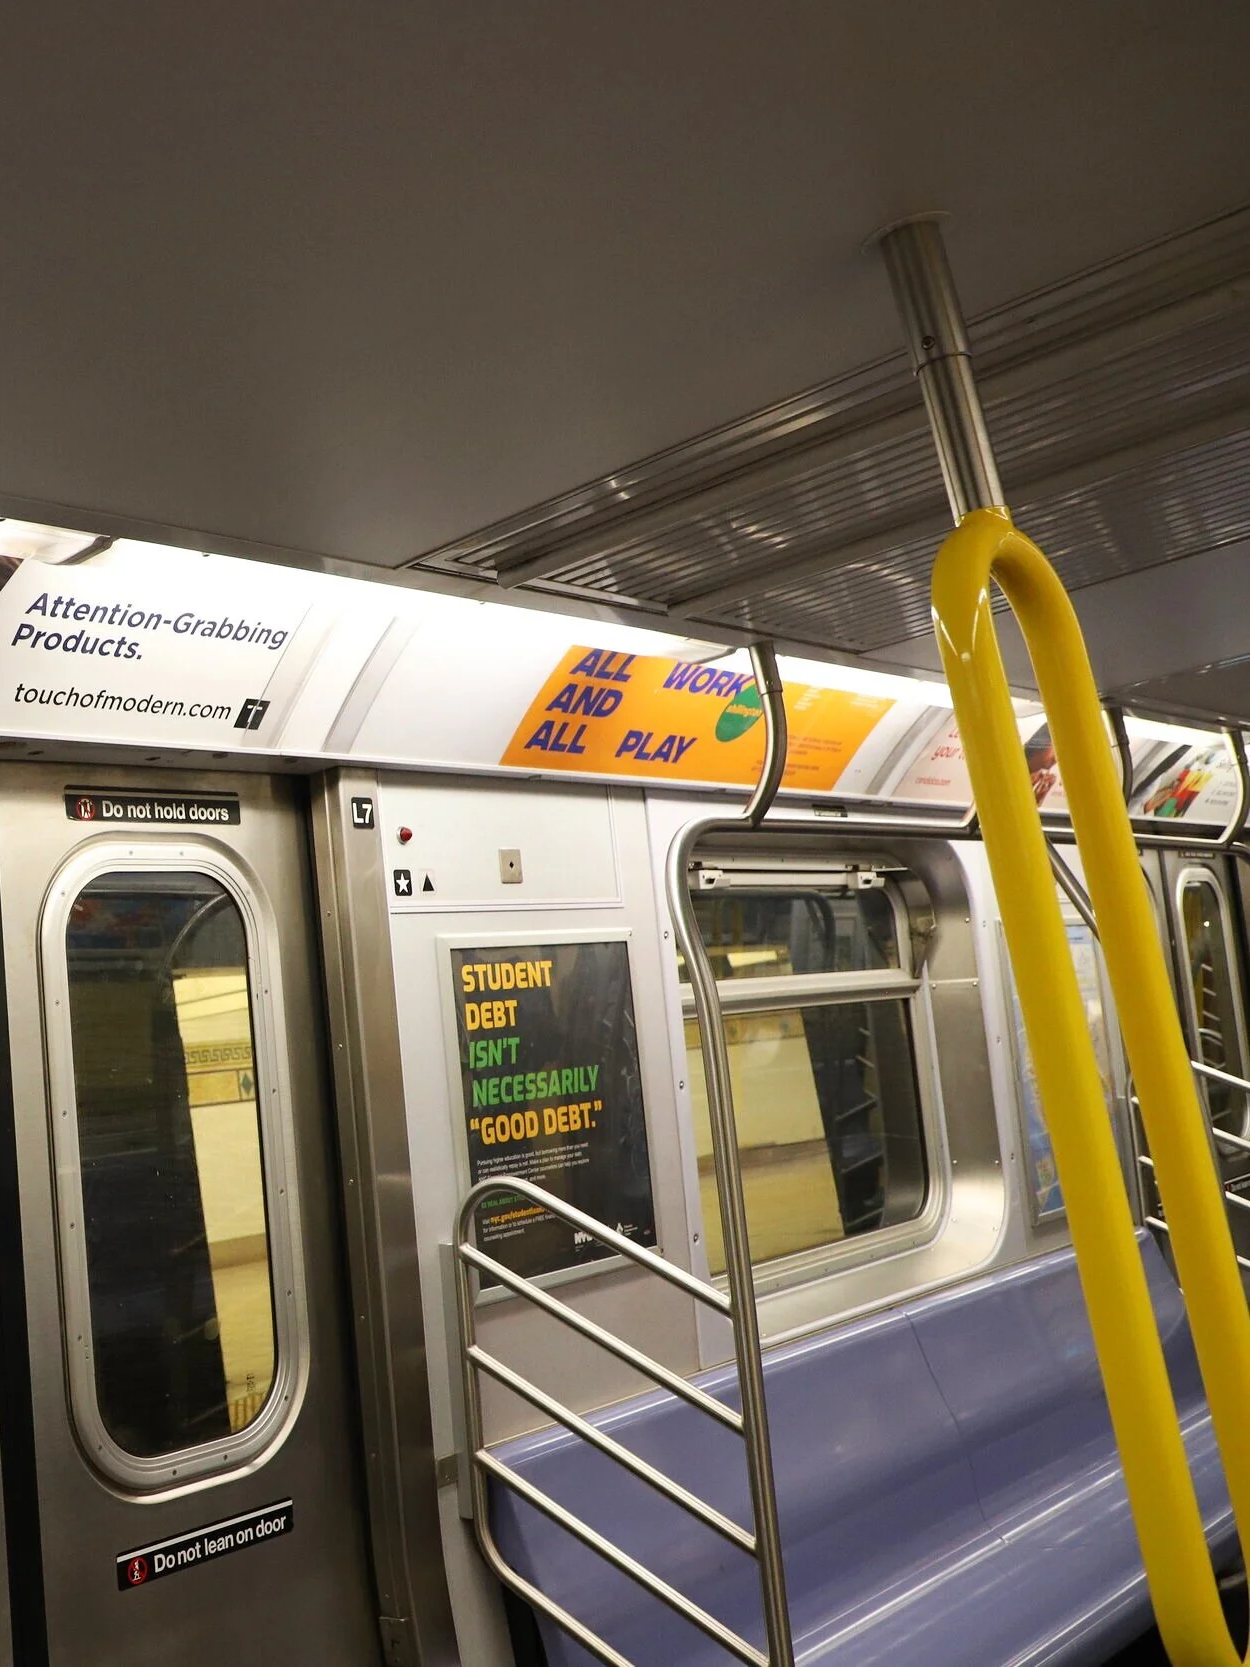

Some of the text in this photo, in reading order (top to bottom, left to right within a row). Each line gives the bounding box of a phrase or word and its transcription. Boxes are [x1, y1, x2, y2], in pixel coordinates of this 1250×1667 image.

[24, 592, 289, 651] Attention-Grabbing
[10, 623, 143, 661] Products.
[569, 648, 637, 683] ALL
[663, 662, 754, 698] WORK
[13, 682, 232, 720] touchofmodern.com
[546, 683, 624, 718] AND
[524, 720, 698, 764] ALL PLAY
[102, 800, 230, 821] Do not hold doors
[352, 802, 372, 825] L7
[461, 960, 553, 993] STUDENT
[465, 999, 518, 1031] DEBT
[469, 1036, 520, 1070] ISN'T
[472, 1064, 600, 1107] NECESSARILY
[470, 1100, 603, 1145] "GOOD DEBT."
[154, 1516, 287, 1573] Do not lean on door
